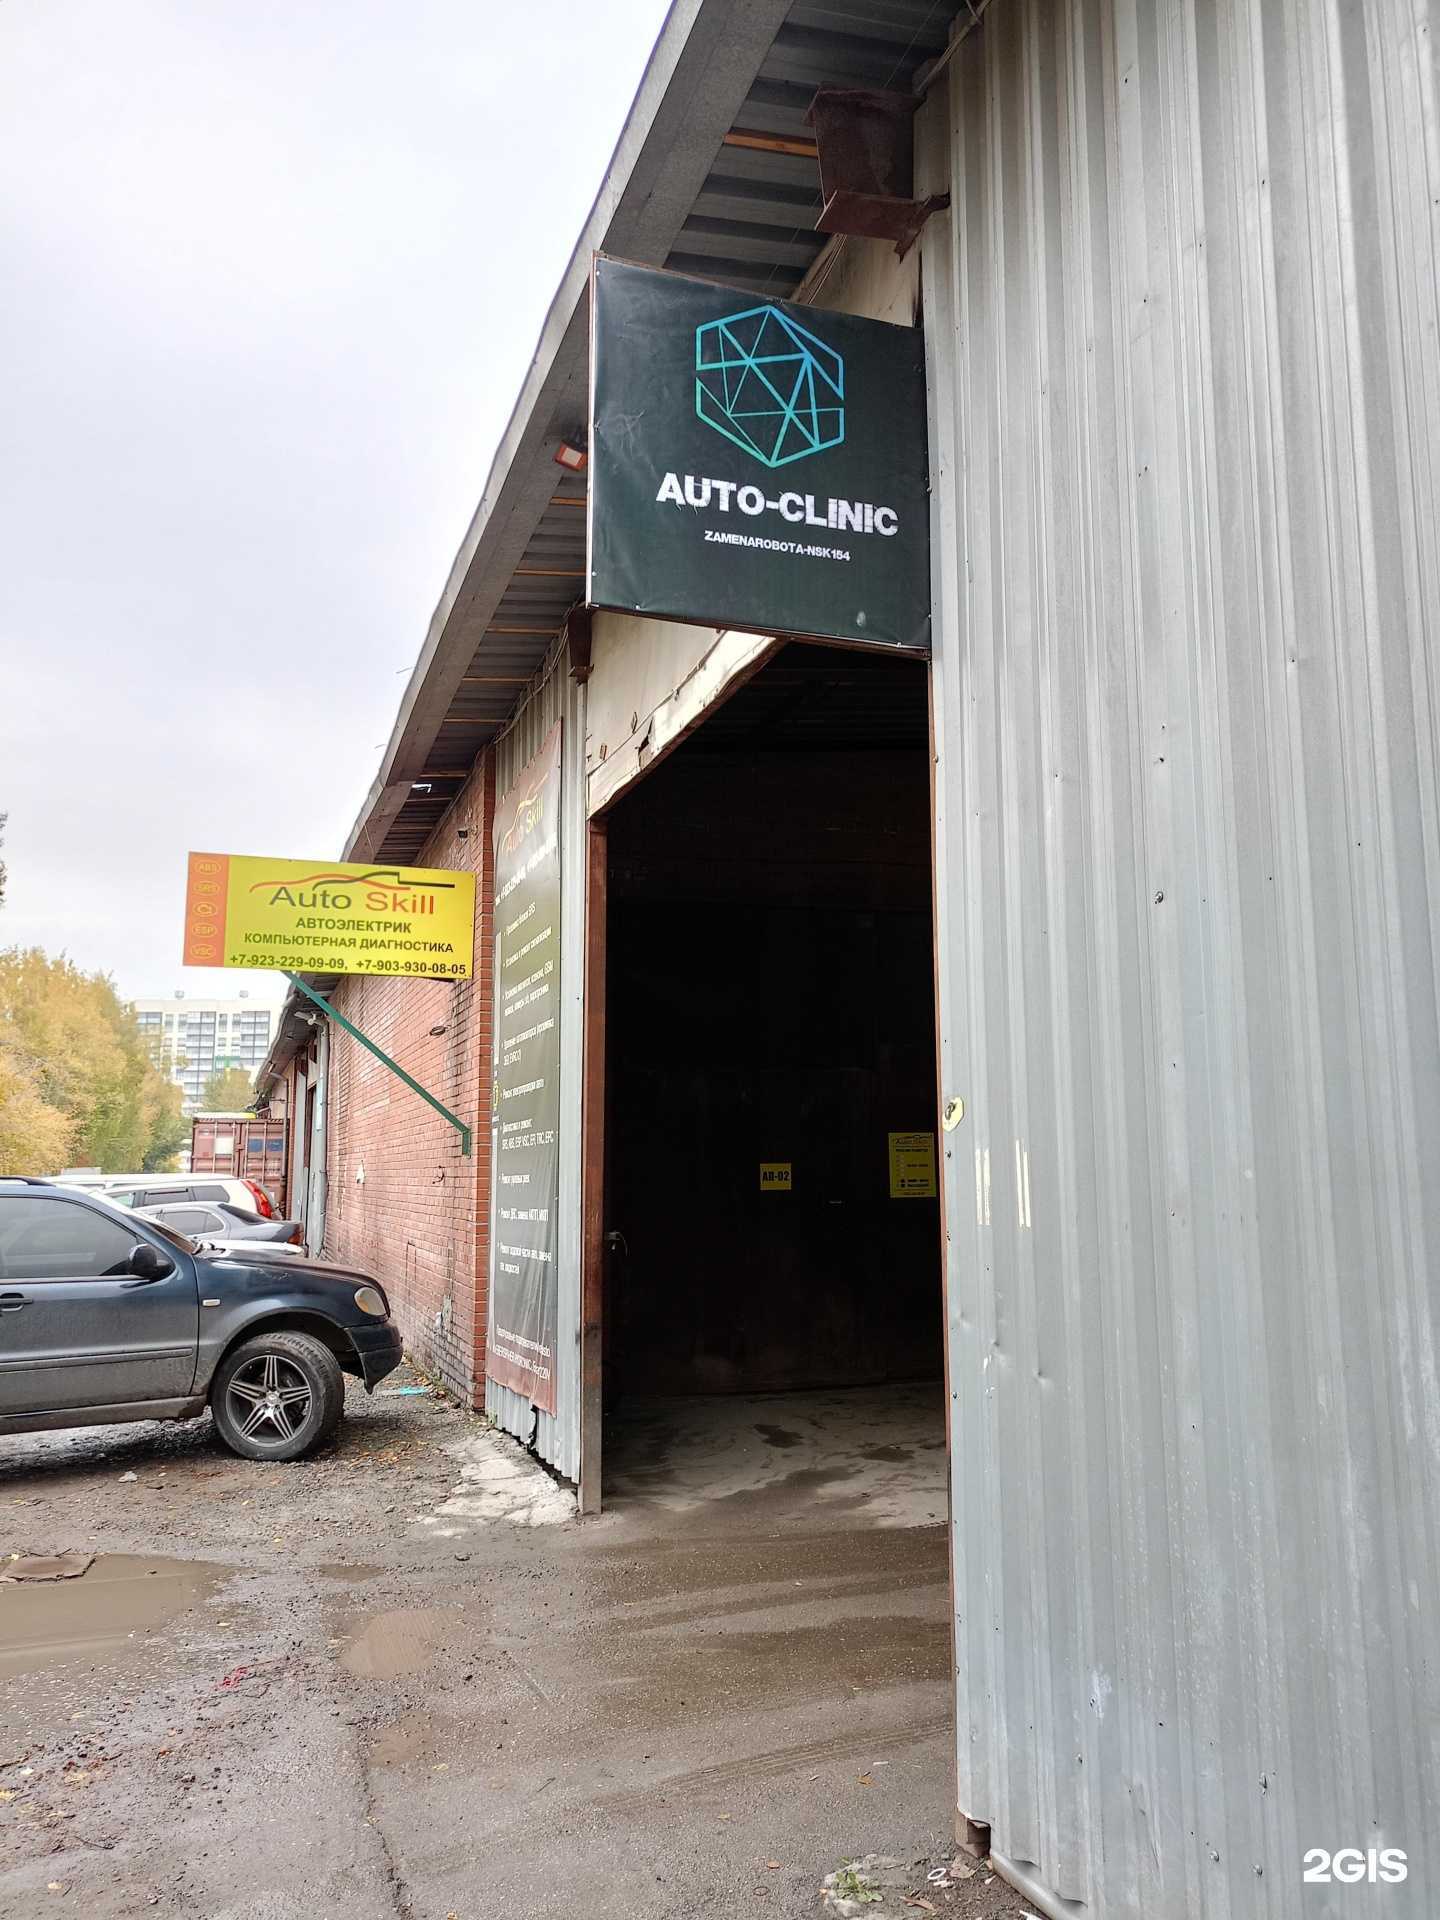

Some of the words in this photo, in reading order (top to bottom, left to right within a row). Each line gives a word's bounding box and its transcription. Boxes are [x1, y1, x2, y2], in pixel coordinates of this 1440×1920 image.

[656, 472, 898, 536] AUTO-CLINIC
[704, 530, 850, 560] ZAMENAROBOTA-NSK154
[269, 886, 352, 909] Auto
[366, 892, 434, 914] Skill
[296, 917, 412, 934] АВТОЭЛЕКТРИК
[244, 932, 357, 948] КОМПЬЮТЕРНАЯ
[360, 938, 454, 953] ДИАГНОСТИКА
[230, 954, 348, 970] +7-923-229-09-09,
[356, 959, 466, 975] +7-903-930-08-05
